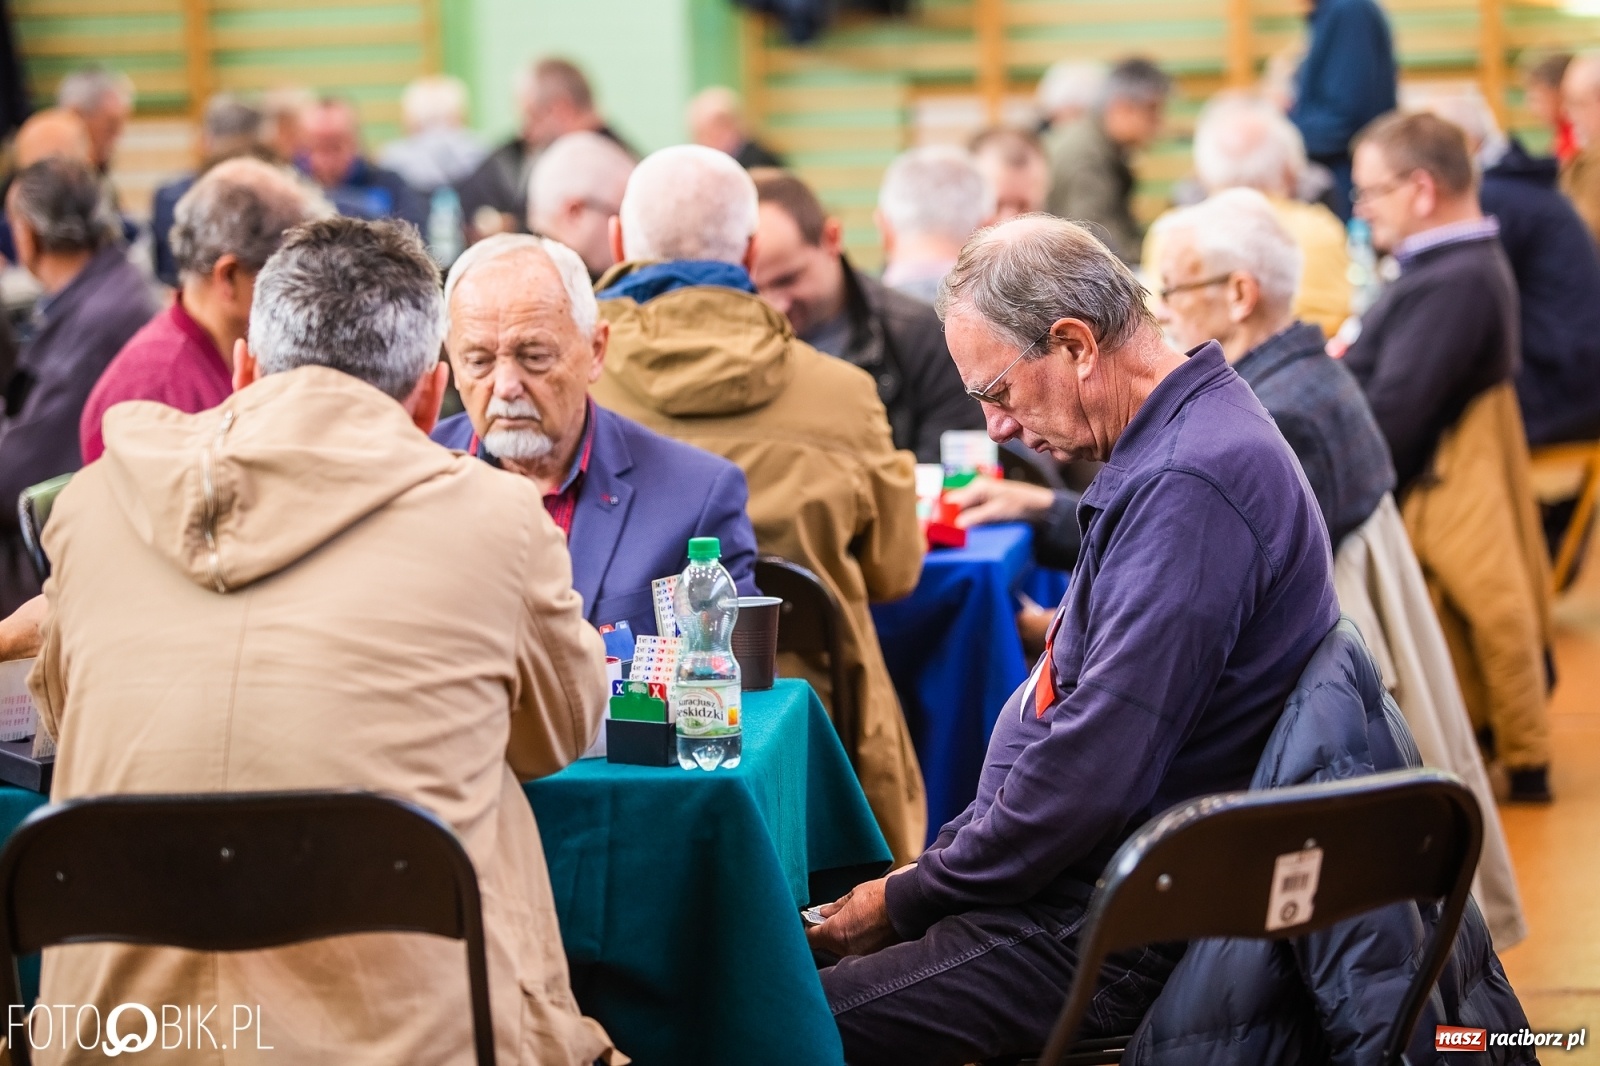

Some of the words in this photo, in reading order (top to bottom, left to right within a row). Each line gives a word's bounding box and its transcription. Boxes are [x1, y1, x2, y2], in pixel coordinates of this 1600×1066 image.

[616, 683, 624, 694] X
[651, 684, 661, 698] X
[679, 698, 716, 708] uracjusz
[676, 707, 724, 720] eskidzki
